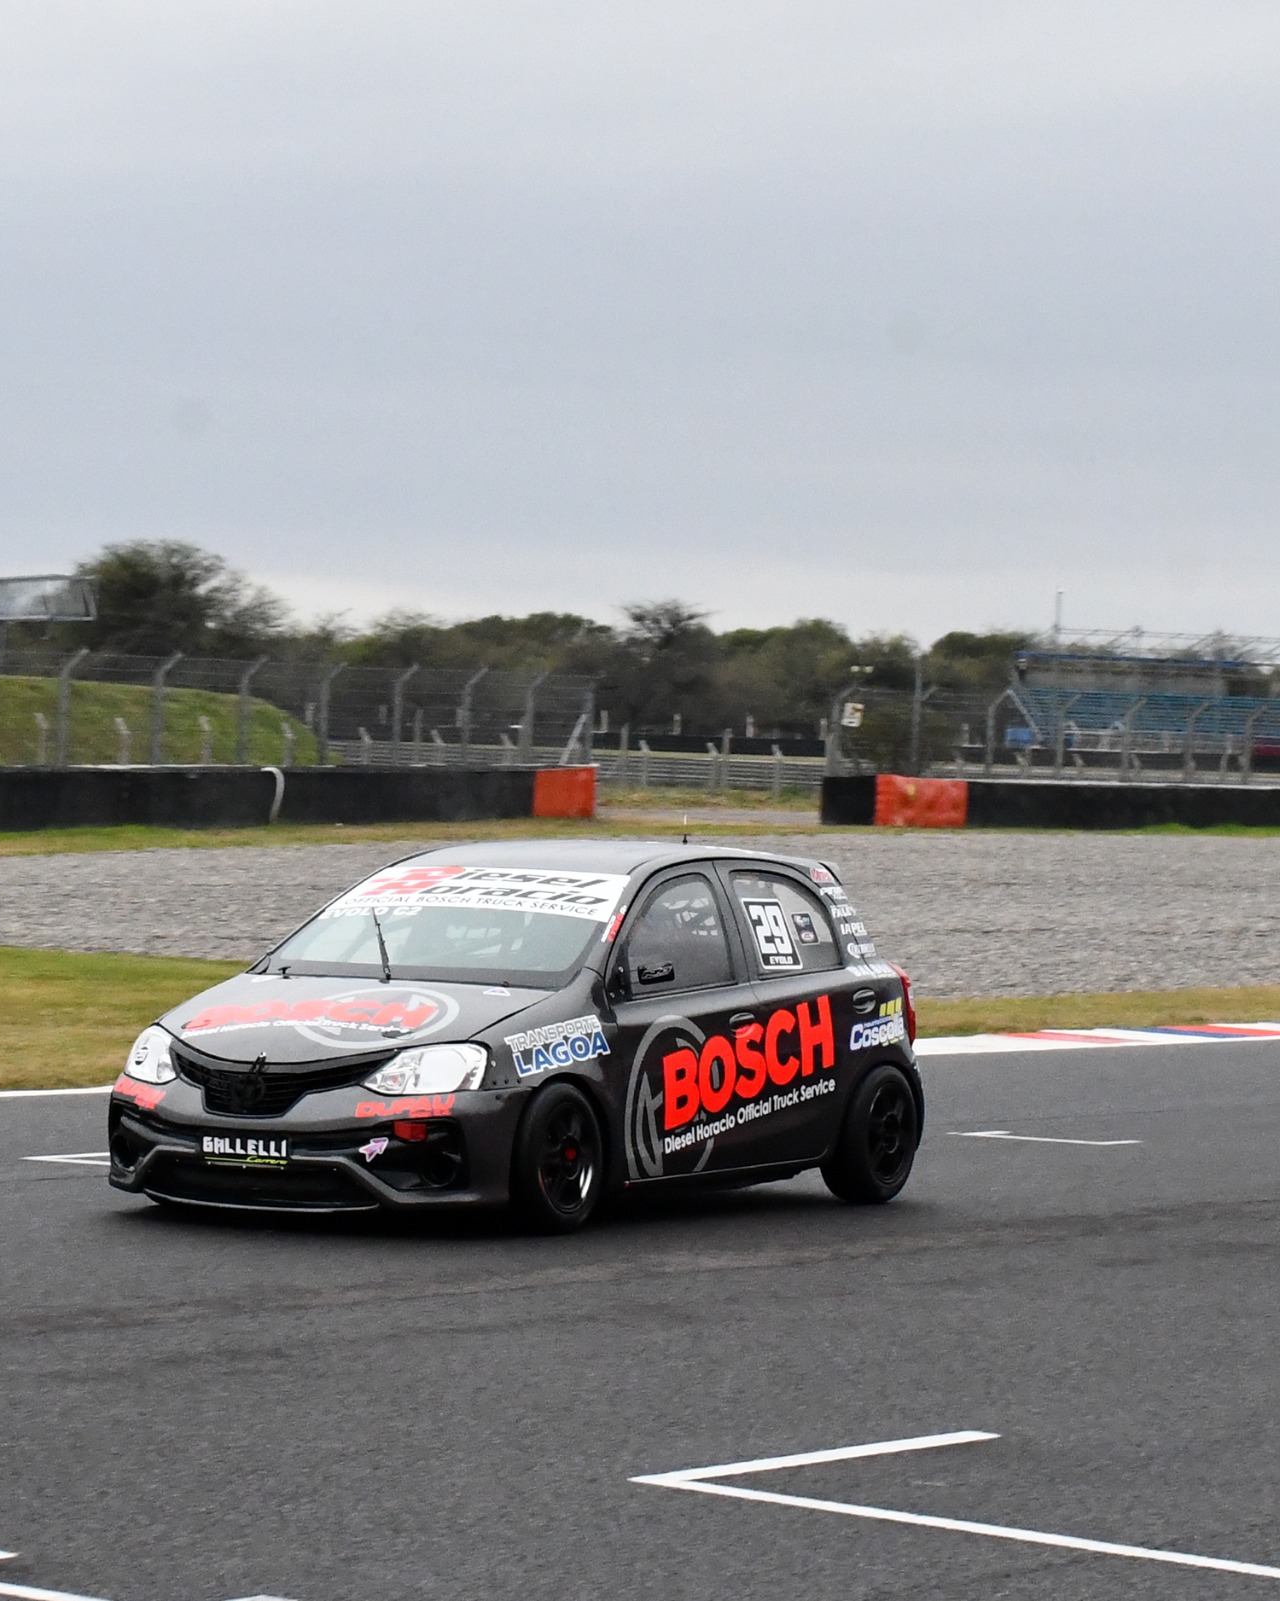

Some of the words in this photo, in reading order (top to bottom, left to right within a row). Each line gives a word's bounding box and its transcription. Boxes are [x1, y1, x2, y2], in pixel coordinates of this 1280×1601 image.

[362, 880, 609, 905] Horacio
[374, 866, 608, 889] Diesel
[345, 895, 410, 905] OFFICIAL
[416, 895, 471, 905] BOSCH
[476, 897, 527, 907] TRUCK
[529, 901, 598, 915] SERVICE
[748, 905, 793, 954] 29
[182, 1000, 437, 1030] BOSCH
[505, 1016, 601, 1053] TRANSPORTE
[514, 1031, 609, 1076] LAGOA
[663, 995, 835, 1131] BOSCH
[664, 1127, 696, 1155] Diesel
[696, 1113, 736, 1142] Horacio
[736, 1097, 772, 1125] Official
[772, 1088, 800, 1112] Truck
[800, 1078, 836, 1102] Service
[202, 1135, 288, 1158] GALLELLI
